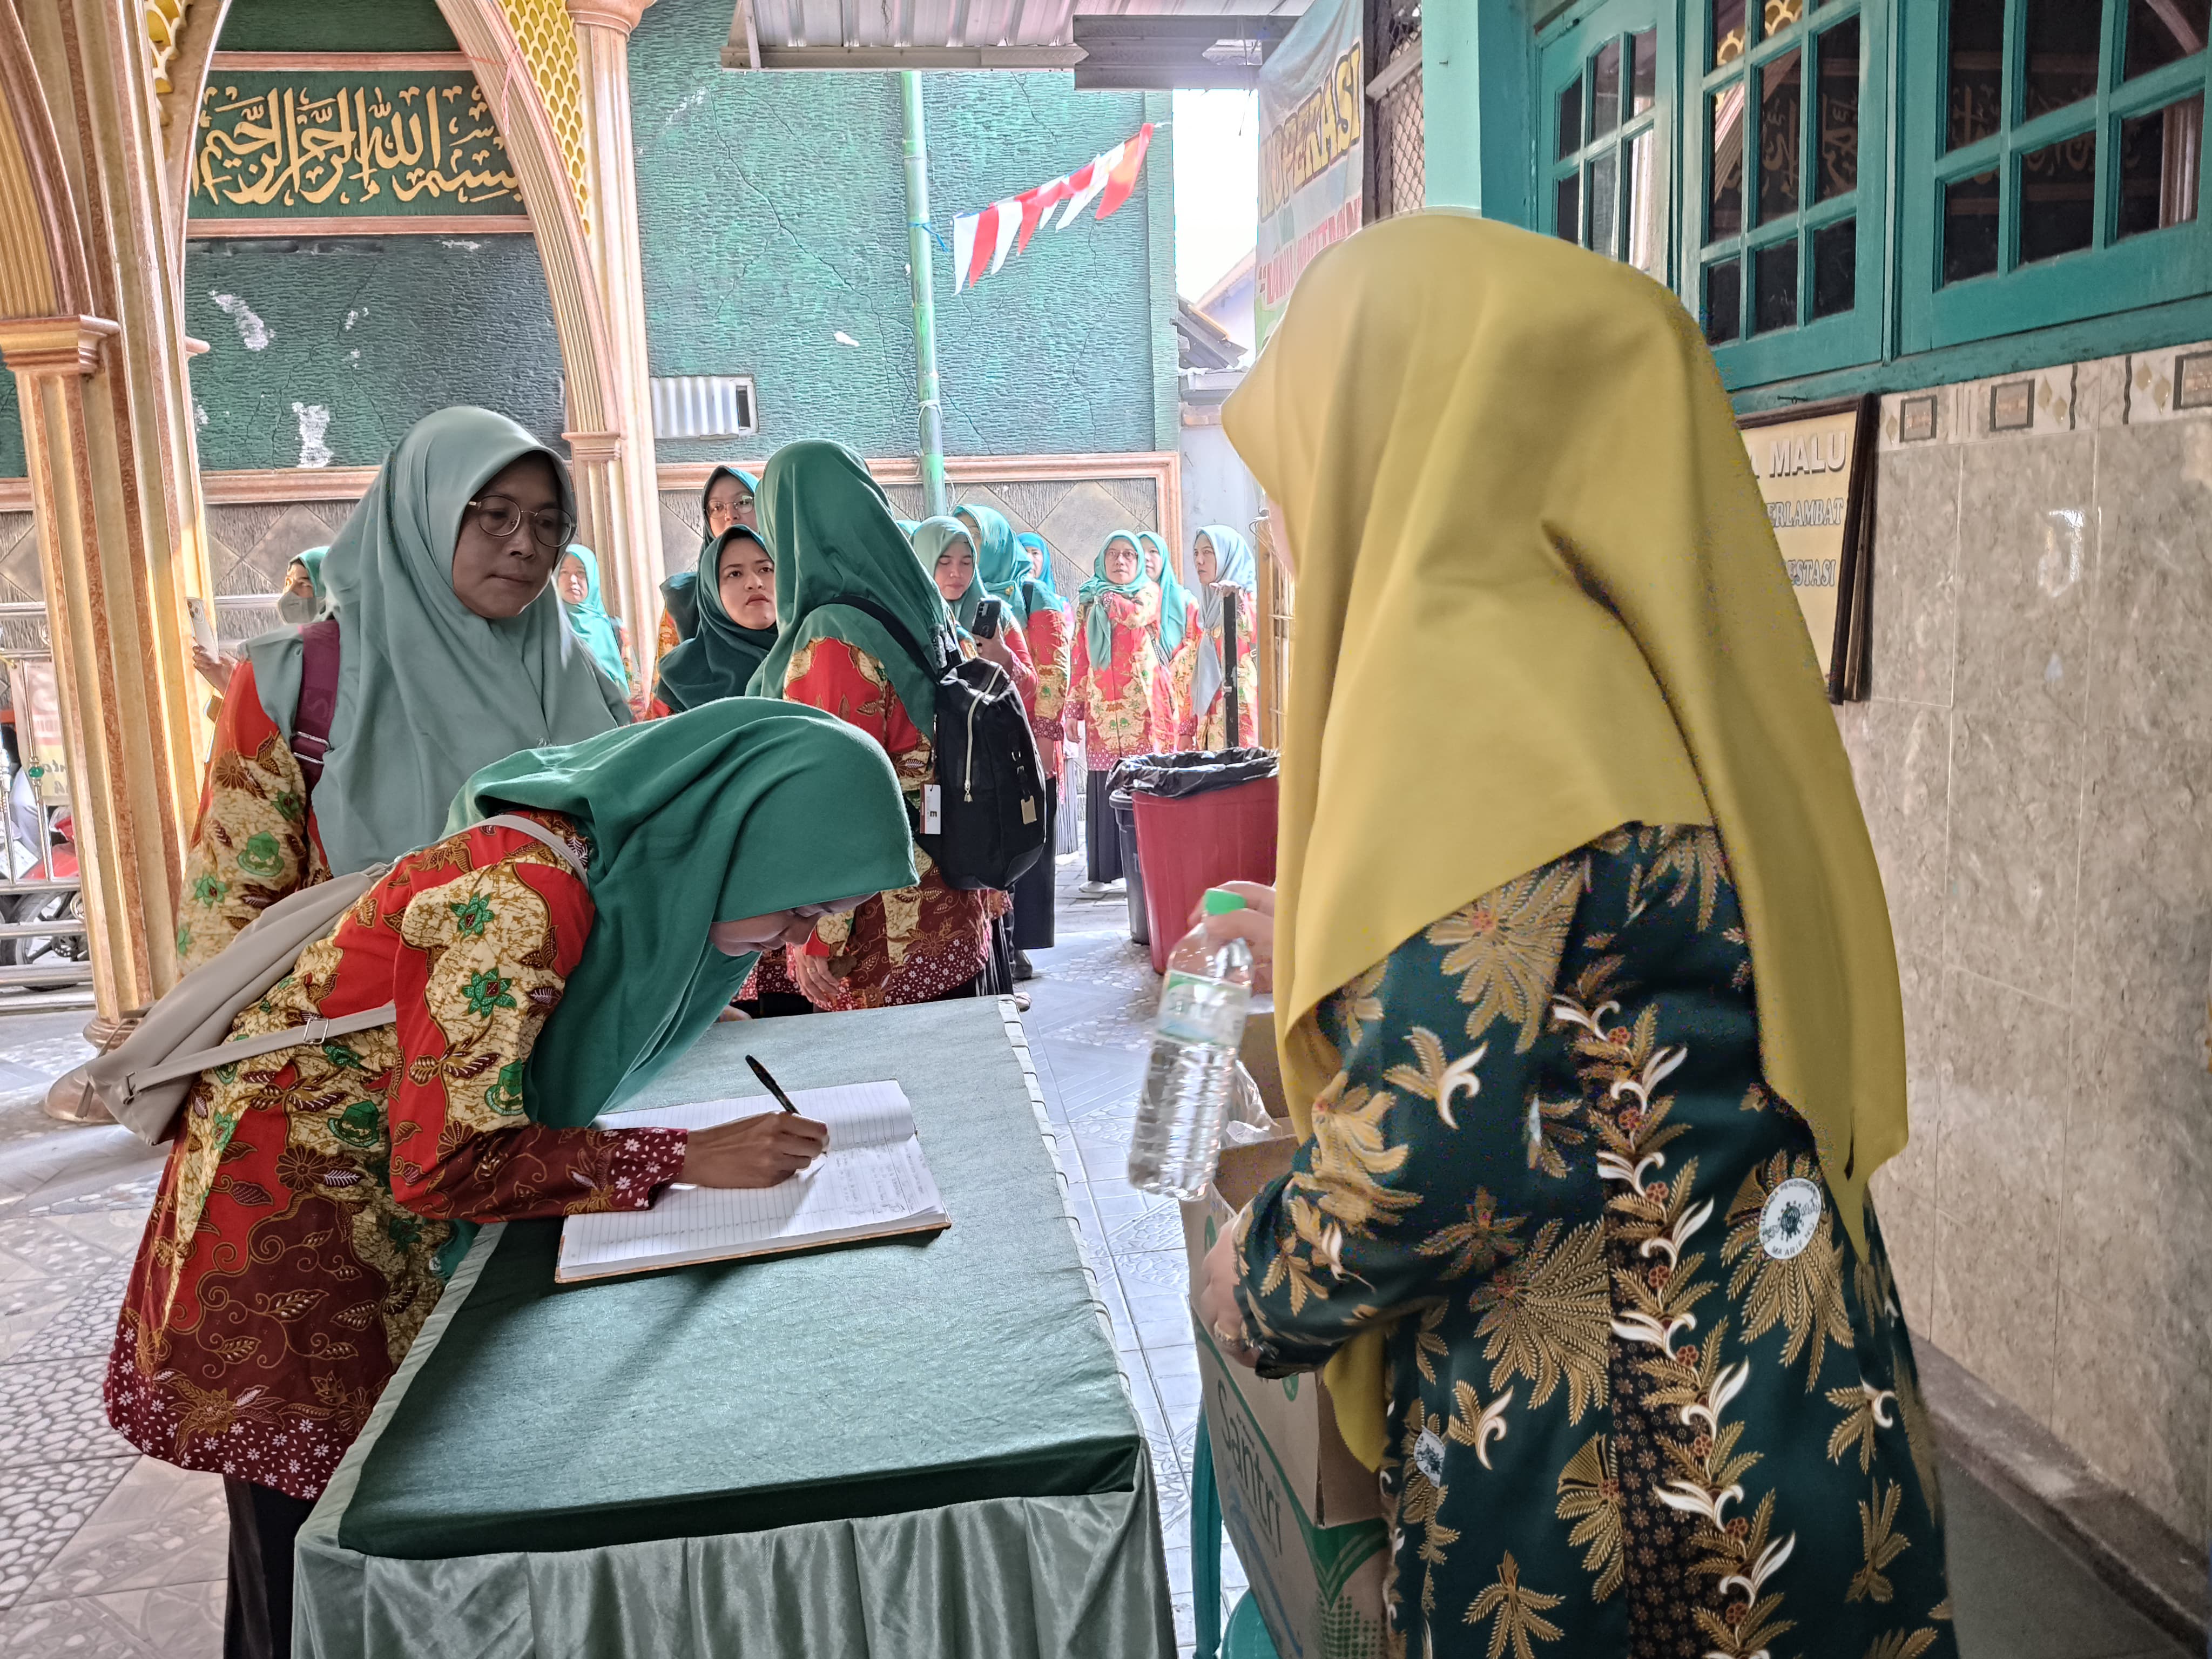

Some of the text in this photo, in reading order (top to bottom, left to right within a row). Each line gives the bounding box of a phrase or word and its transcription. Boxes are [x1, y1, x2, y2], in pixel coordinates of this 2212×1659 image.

[1260, 41, 1361, 224] KOPERASI
[1769, 431, 1846, 478] MALU
[1766, 497, 1844, 528] ERLAMBAT
[1787, 558, 1837, 586] ESTASI
